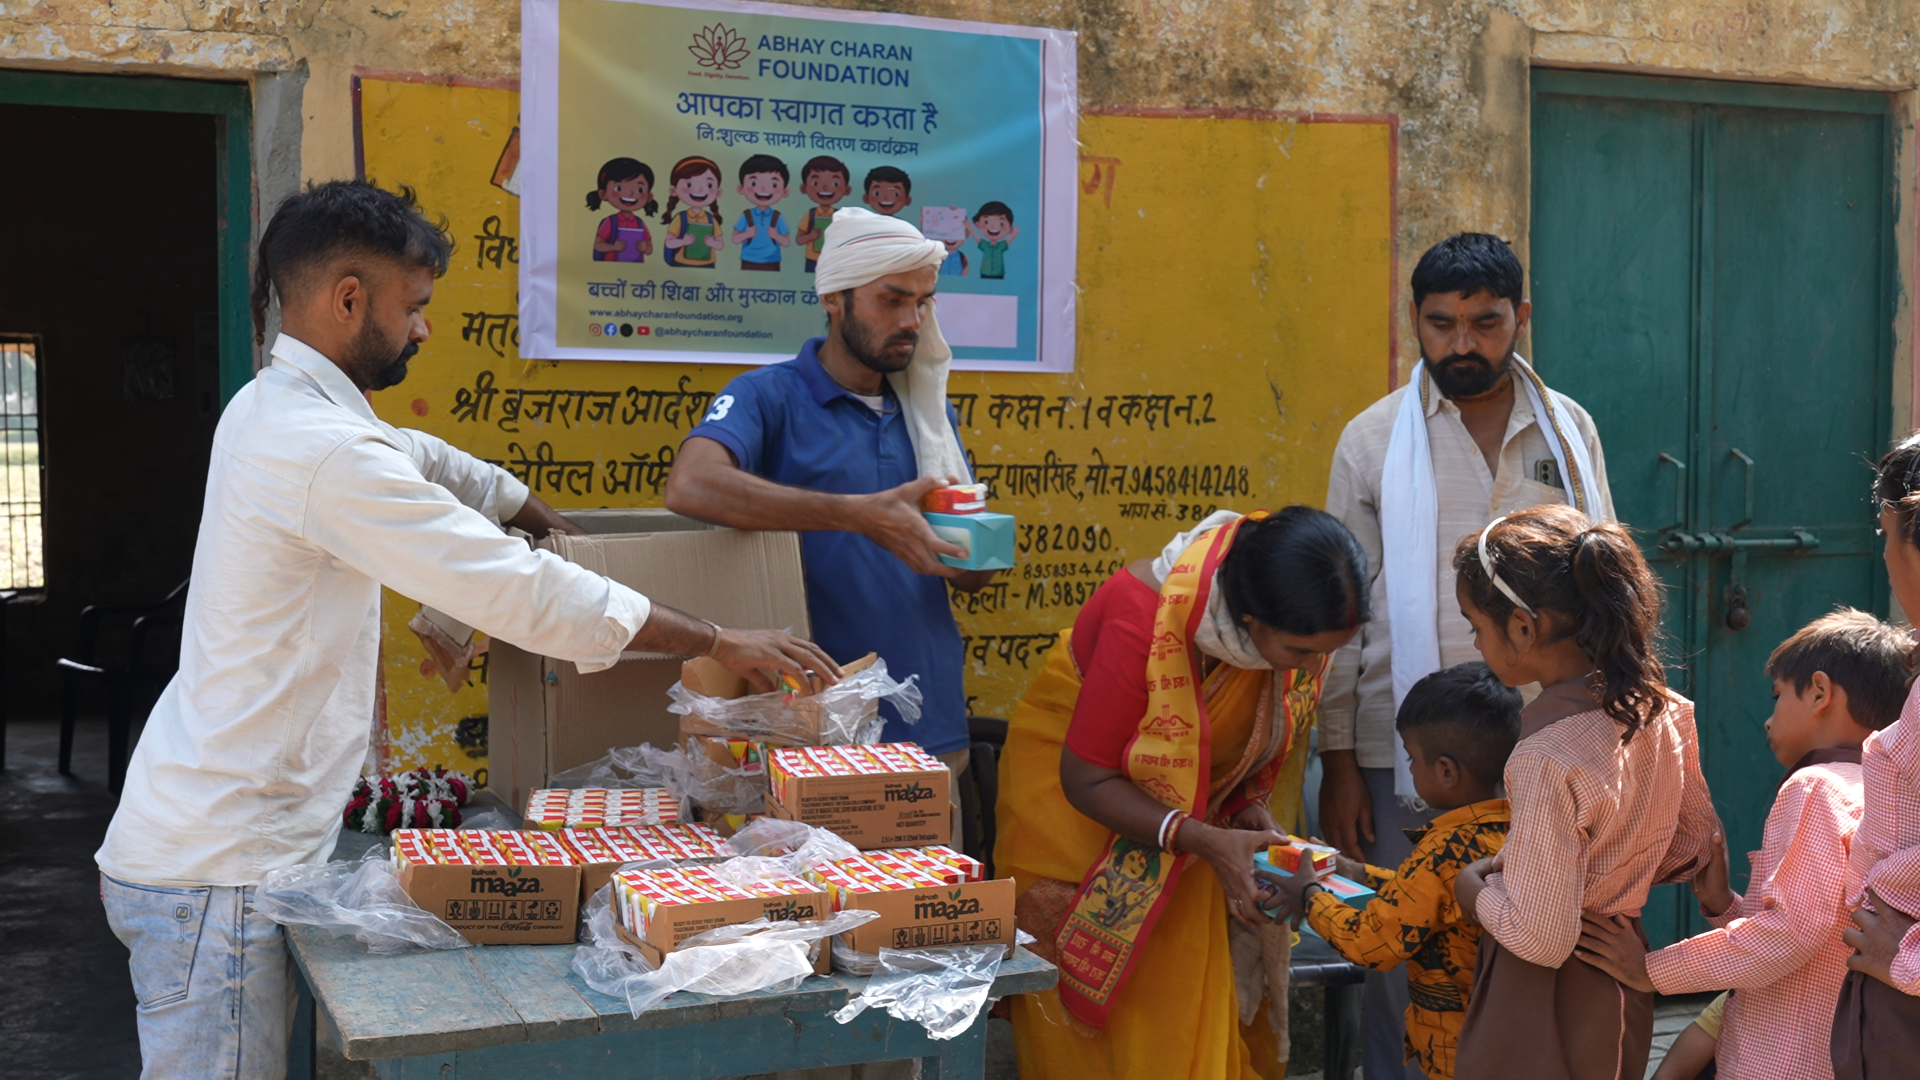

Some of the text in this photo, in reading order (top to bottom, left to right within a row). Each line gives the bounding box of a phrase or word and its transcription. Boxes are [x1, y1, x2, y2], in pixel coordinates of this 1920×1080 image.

[757, 34, 913, 61] ABHAY CHARAN
[758, 58, 910, 87] FOUNDATION
[676, 91, 939, 134] आपका स्वागत करता है
[763, 131, 806, 149] सामग्री
[810, 131, 856, 152] वितरण
[860, 136, 919, 156] कार्यक्रम
[587, 278, 627, 299] बच्चों
[631, 280, 657, 300] की
[661, 280, 702, 302] शिक्षा
[705, 282, 735, 304] और
[738, 286, 798, 308] मुस्कान
[589, 308, 743, 324] www.abhaycharanfoundation.org
[654, 326, 773, 340] @abhaycharanfoundation
[450, 370, 499, 423] श्री
[705, 394, 734, 423] 3
[885, 787, 933, 803] maaza
[470, 877, 541, 898] maaza
[763, 904, 815, 921] maaza
[914, 897, 980, 920] maaza
